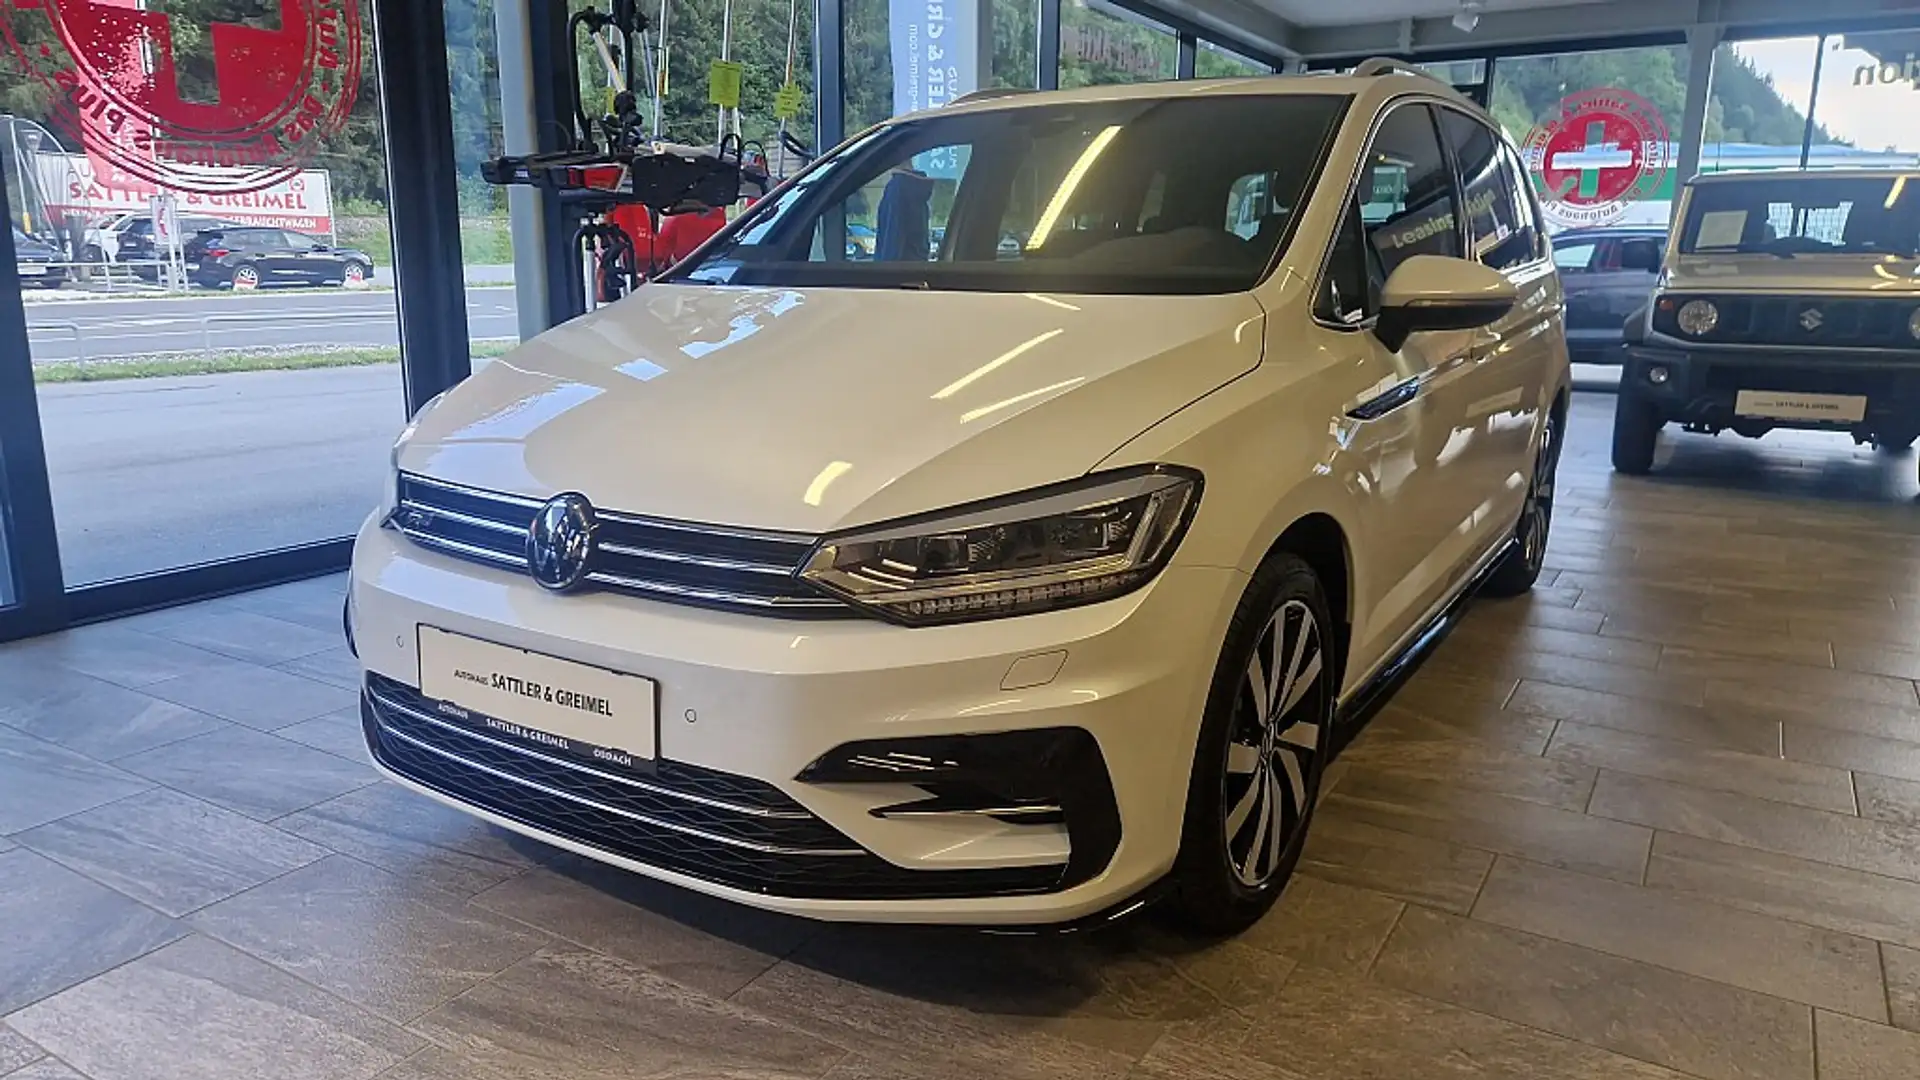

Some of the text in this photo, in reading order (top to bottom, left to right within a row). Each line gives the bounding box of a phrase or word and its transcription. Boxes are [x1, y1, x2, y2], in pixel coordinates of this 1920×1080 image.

[208, 192, 307, 210] GREIMEL
[491, 672, 542, 700] SATTLER
[543, 686, 553, 703] &
[555, 689, 613, 717] GREIMEL
[485, 717, 521, 738] SATTLER
[521, 729, 529, 739] &
[529, 730, 570, 750] GREIMEL
